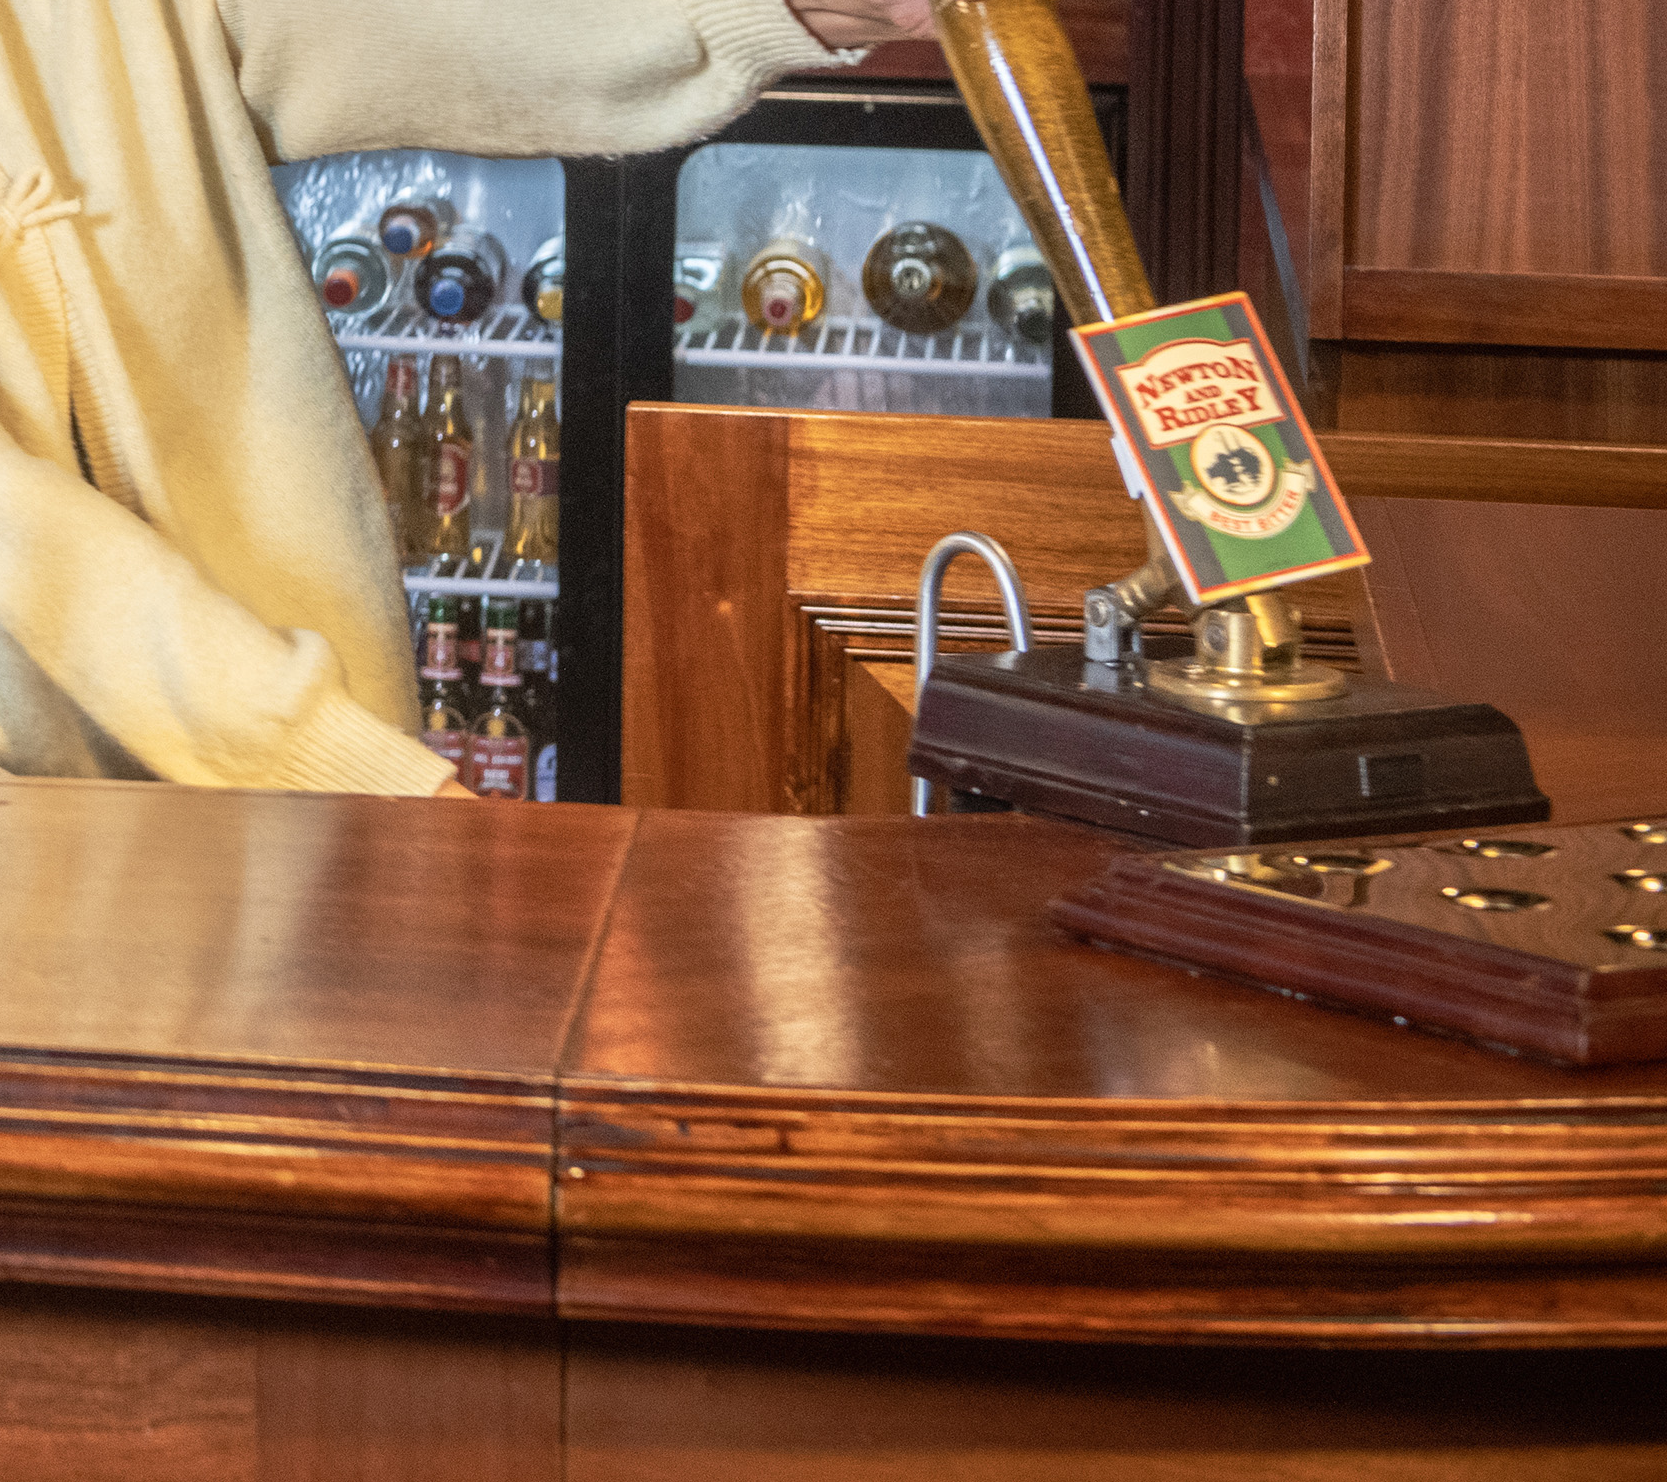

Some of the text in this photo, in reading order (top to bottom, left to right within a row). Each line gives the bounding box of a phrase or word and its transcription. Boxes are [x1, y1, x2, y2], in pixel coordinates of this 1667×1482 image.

[1136, 356, 1260, 409] NEWTON
[1184, 384, 1222, 405] AND
[1153, 386, 1263, 432] RIDLEY
[1209, 510, 1252, 531] BEST
